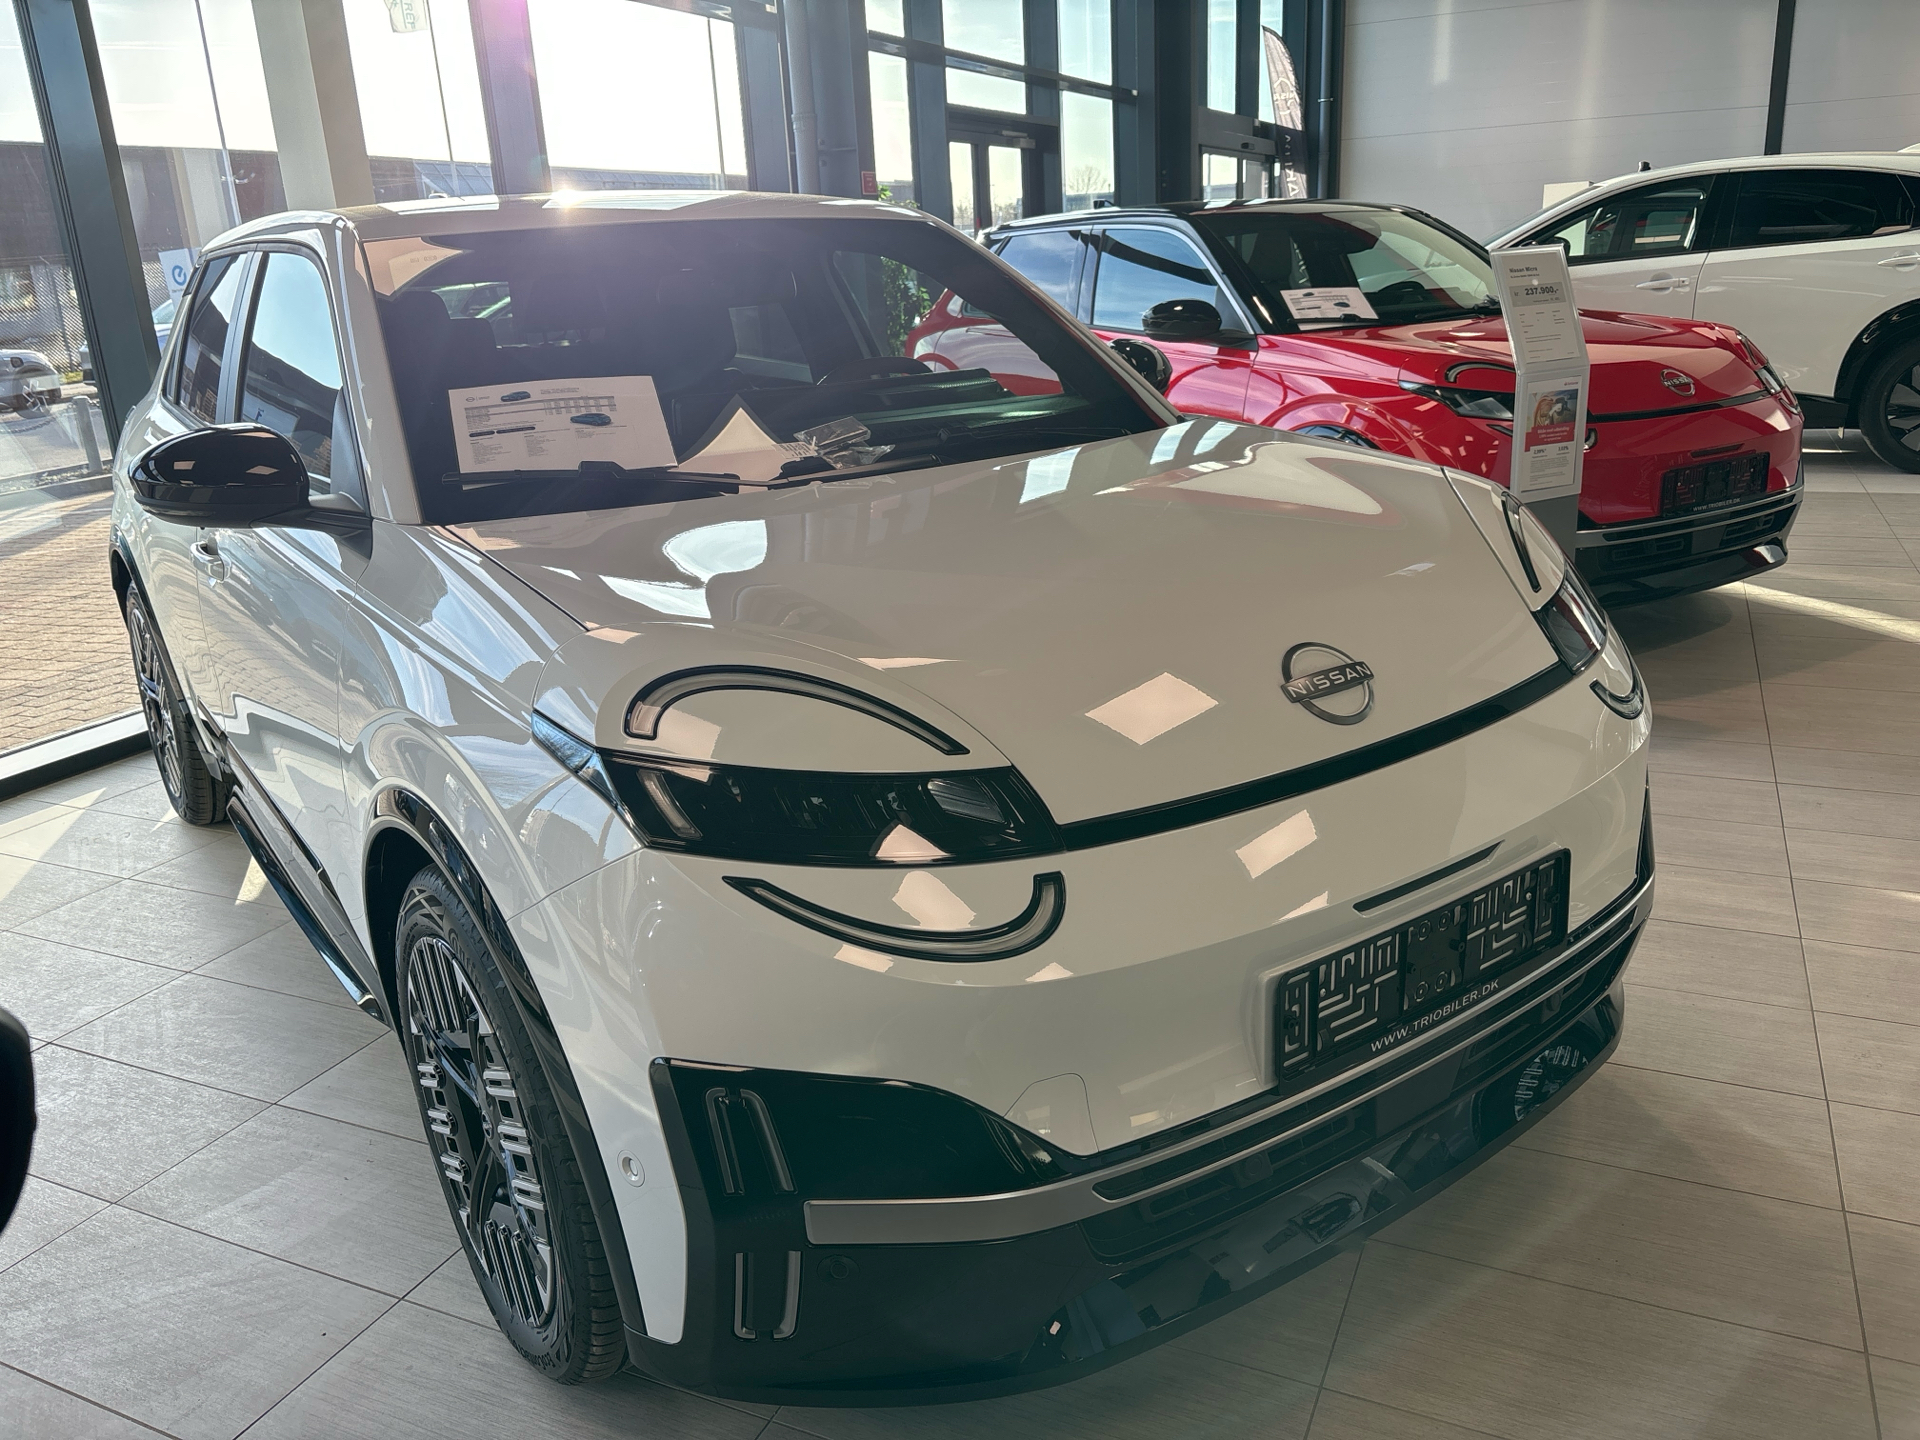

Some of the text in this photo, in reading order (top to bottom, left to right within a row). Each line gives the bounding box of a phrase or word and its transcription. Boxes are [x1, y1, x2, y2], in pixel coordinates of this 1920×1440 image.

[1663, 377, 1692, 387] NISSA
[1692, 498, 1741, 512] WWW.TRIOBILER.DK
[1287, 663, 1371, 698] NISSAN
[1370, 978, 1501, 1053] WWW.TRIOBILER.DK
